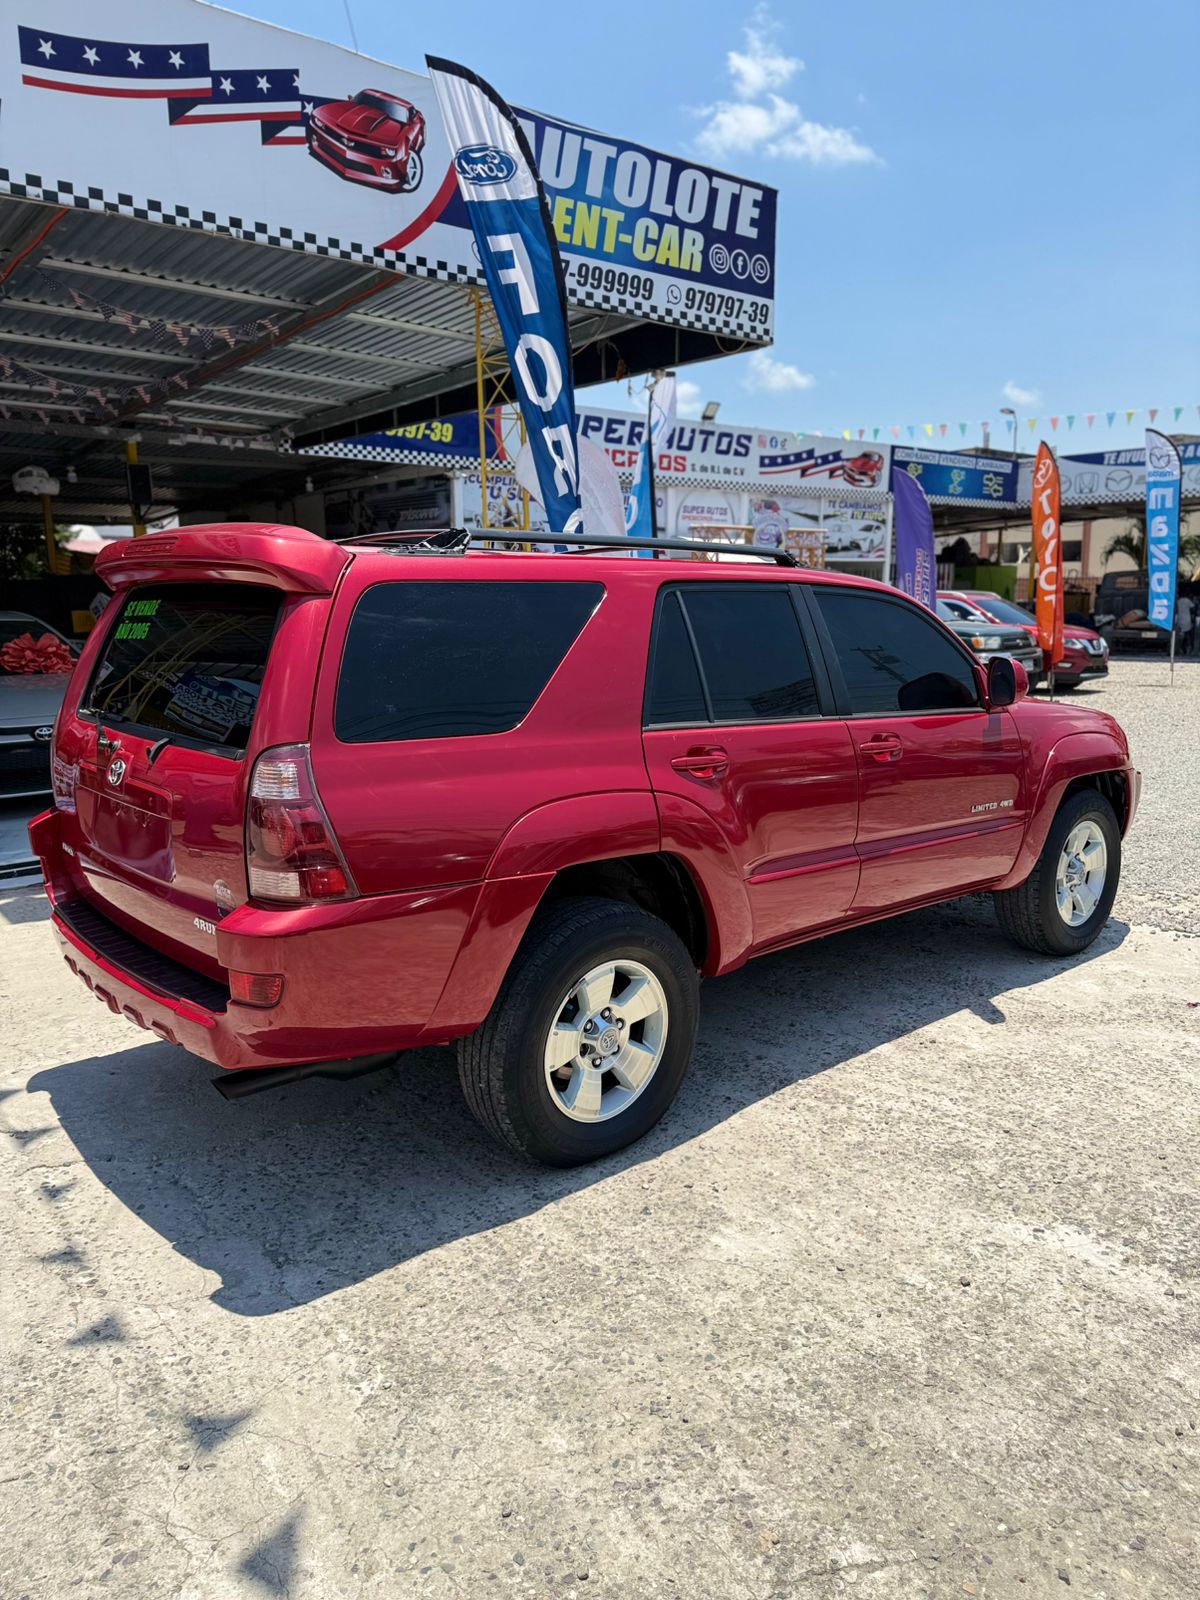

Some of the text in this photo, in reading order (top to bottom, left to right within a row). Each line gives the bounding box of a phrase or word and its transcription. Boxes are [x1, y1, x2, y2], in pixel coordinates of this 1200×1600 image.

[518, 117, 763, 240] UTOLOTE
[548, 195, 705, 273] ENT-CAR
[684, 287, 770, 325] 979797-39
[971, 799, 1014, 813] LIMITED 4WD
